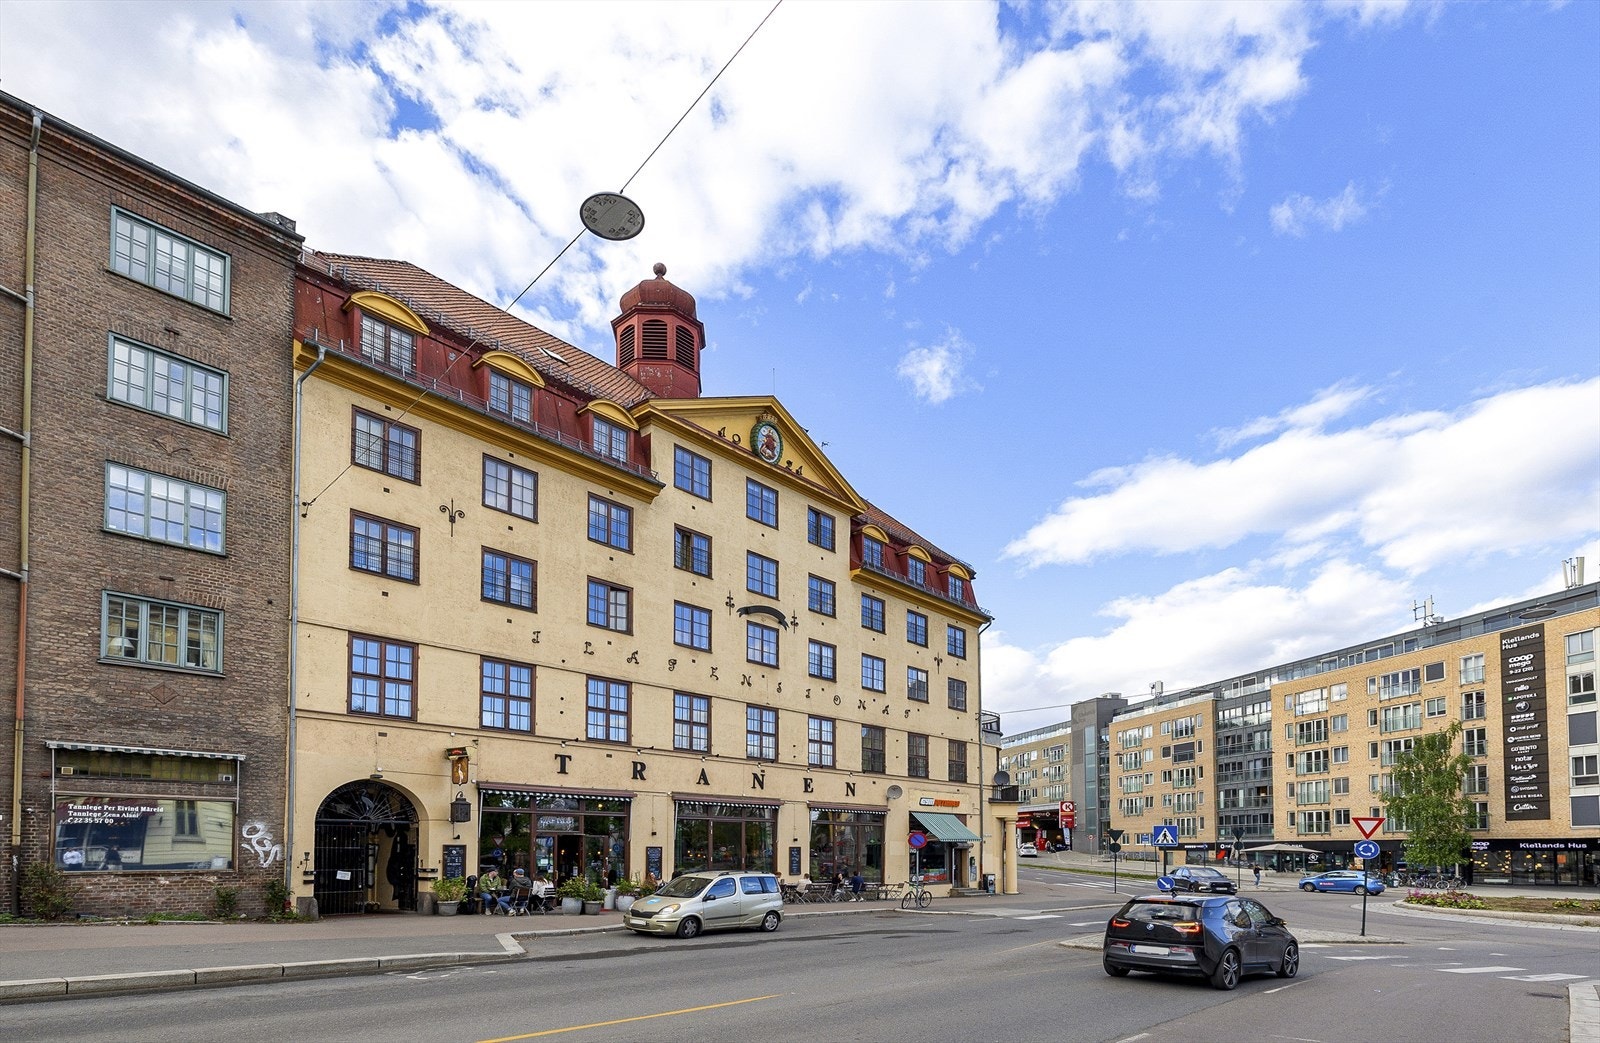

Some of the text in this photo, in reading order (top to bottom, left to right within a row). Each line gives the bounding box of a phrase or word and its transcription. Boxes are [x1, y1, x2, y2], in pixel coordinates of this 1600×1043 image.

[1508, 653, 1534, 663] coop
[554, 753, 857, 797] TRANEN
[117, 804, 139, 812] Eivind
